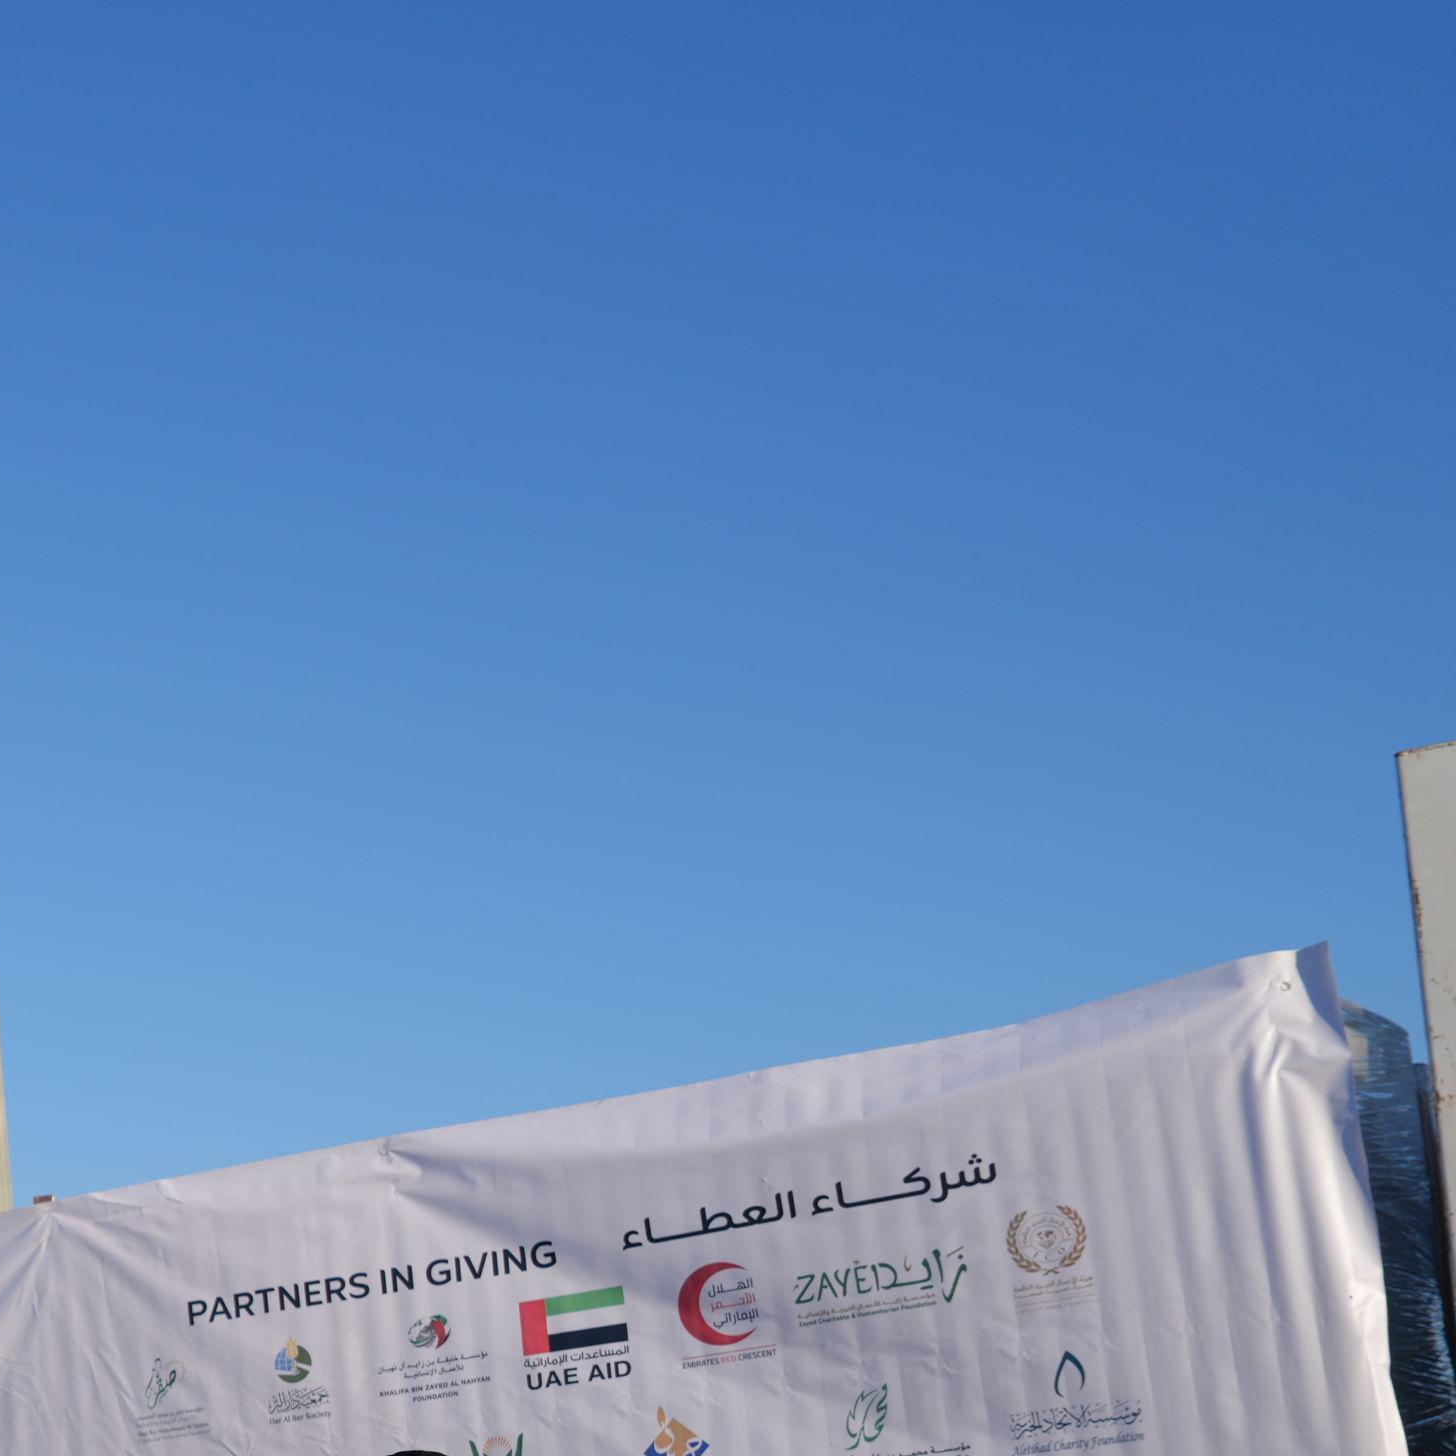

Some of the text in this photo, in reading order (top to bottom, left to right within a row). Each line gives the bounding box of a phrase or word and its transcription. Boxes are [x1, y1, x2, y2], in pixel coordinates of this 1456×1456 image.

[622, 1153, 997, 1250] شركاء العطاء
[188, 1241, 557, 1325] PARTNERS IN GIVING
[708, 1278, 753, 1298] الهلال
[524, 1345, 629, 1370] المساعدات الإماراتية
[682, 1357, 719, 1369] EMIRATES
[738, 1349, 776, 1361] CRESCENT
[379, 1388, 409, 1398] KHALIFA
[426, 1382, 448, 1390] ZAYED
[461, 1375, 490, 1385] NAHYAN
[526, 1360, 632, 1390] UAE AID
[413, 1391, 459, 1402] FOUNDATION
[1054, 1438, 1088, 1452] Charity
[1089, 1432, 1145, 1450] Foundation
